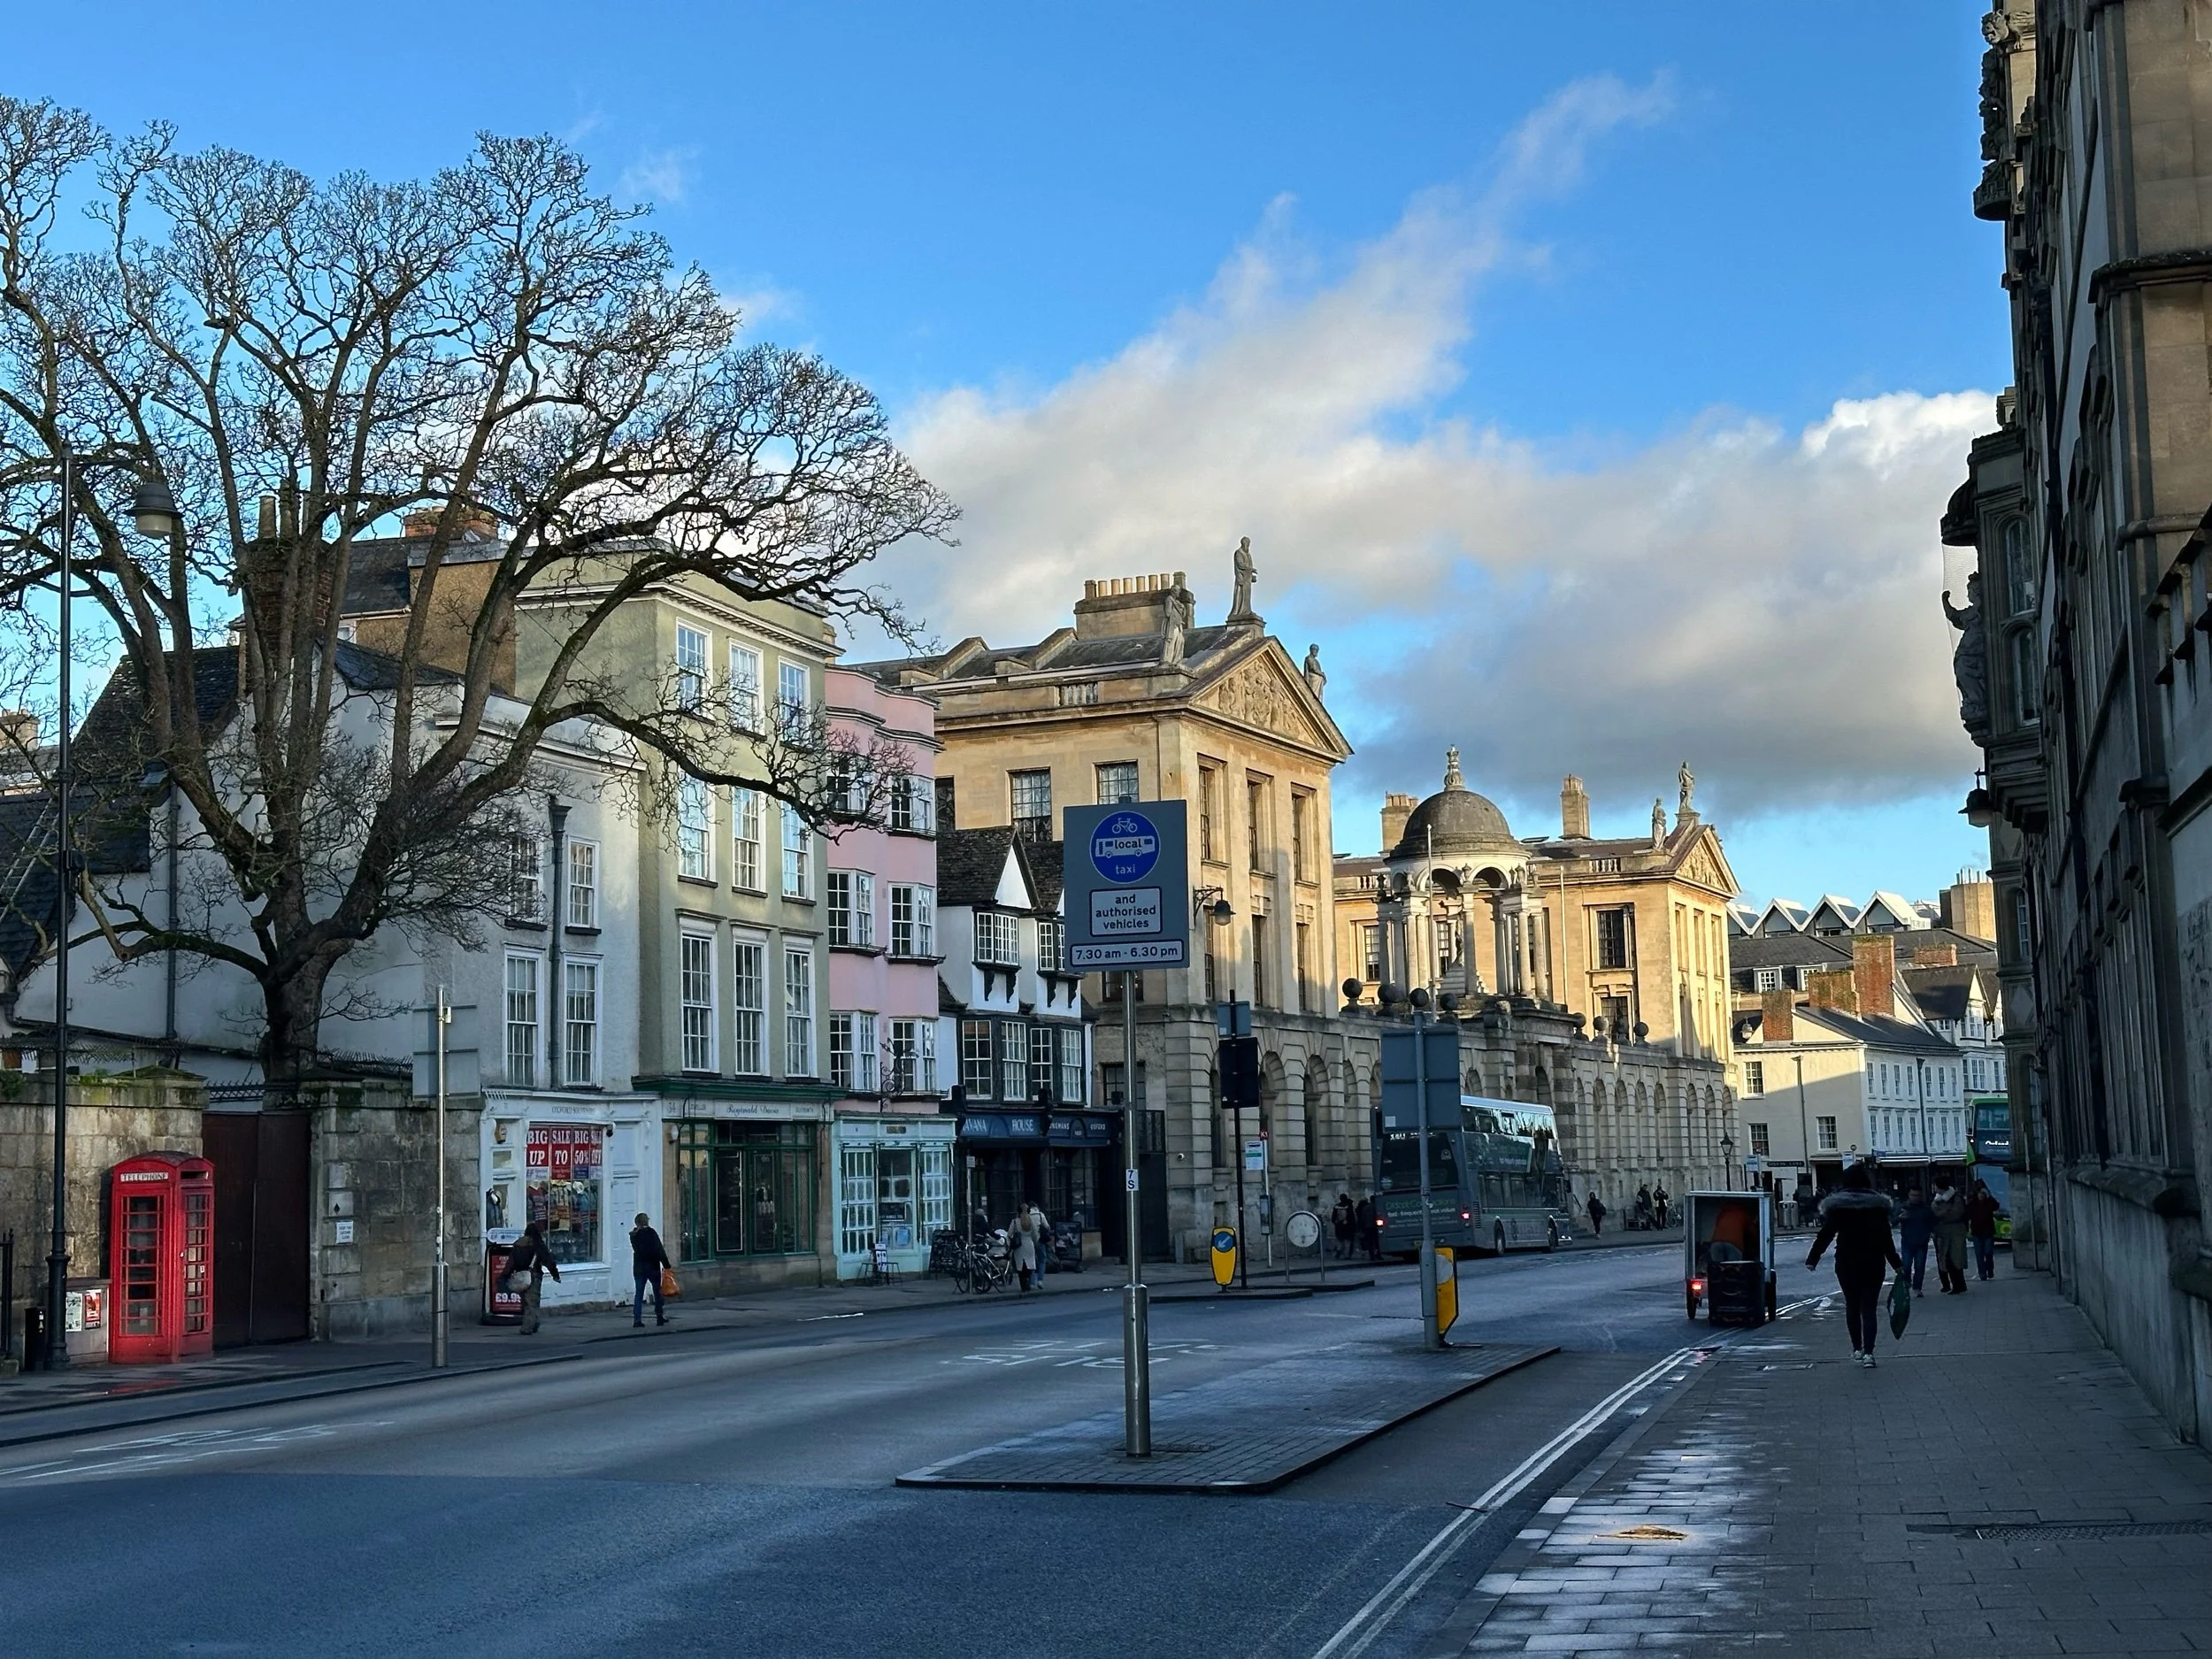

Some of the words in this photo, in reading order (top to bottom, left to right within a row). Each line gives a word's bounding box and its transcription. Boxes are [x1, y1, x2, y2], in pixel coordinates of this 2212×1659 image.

[1115, 838, 1142, 849] local
[1116, 864, 1136, 874] taxi
[1115, 894, 1136, 904] and
[1095, 905, 1156, 918] authorised
[1102, 919, 1149, 930] vehicles
[1075, 949, 1102, 960] 7.30
[1130, 946, 1158, 957] 6.30
[1160, 948, 1178, 958] pm
[963, 1118, 987, 1132] AVANA
[1011, 1118, 1034, 1132] HOUSE
[526, 1130, 549, 1144] BIG
[551, 1130, 571, 1144] SALE
[574, 1130, 589, 1144] BIG
[529, 1150, 545, 1165] UP
[554, 1149, 568, 1165] TO
[574, 1149, 589, 1165] 50%
[591, 1149, 602, 1164] OFF
[122, 1172, 168, 1181] TELEPHONE
[1127, 1170, 1134, 1179] 7
[1127, 1179, 1135, 1190] S
